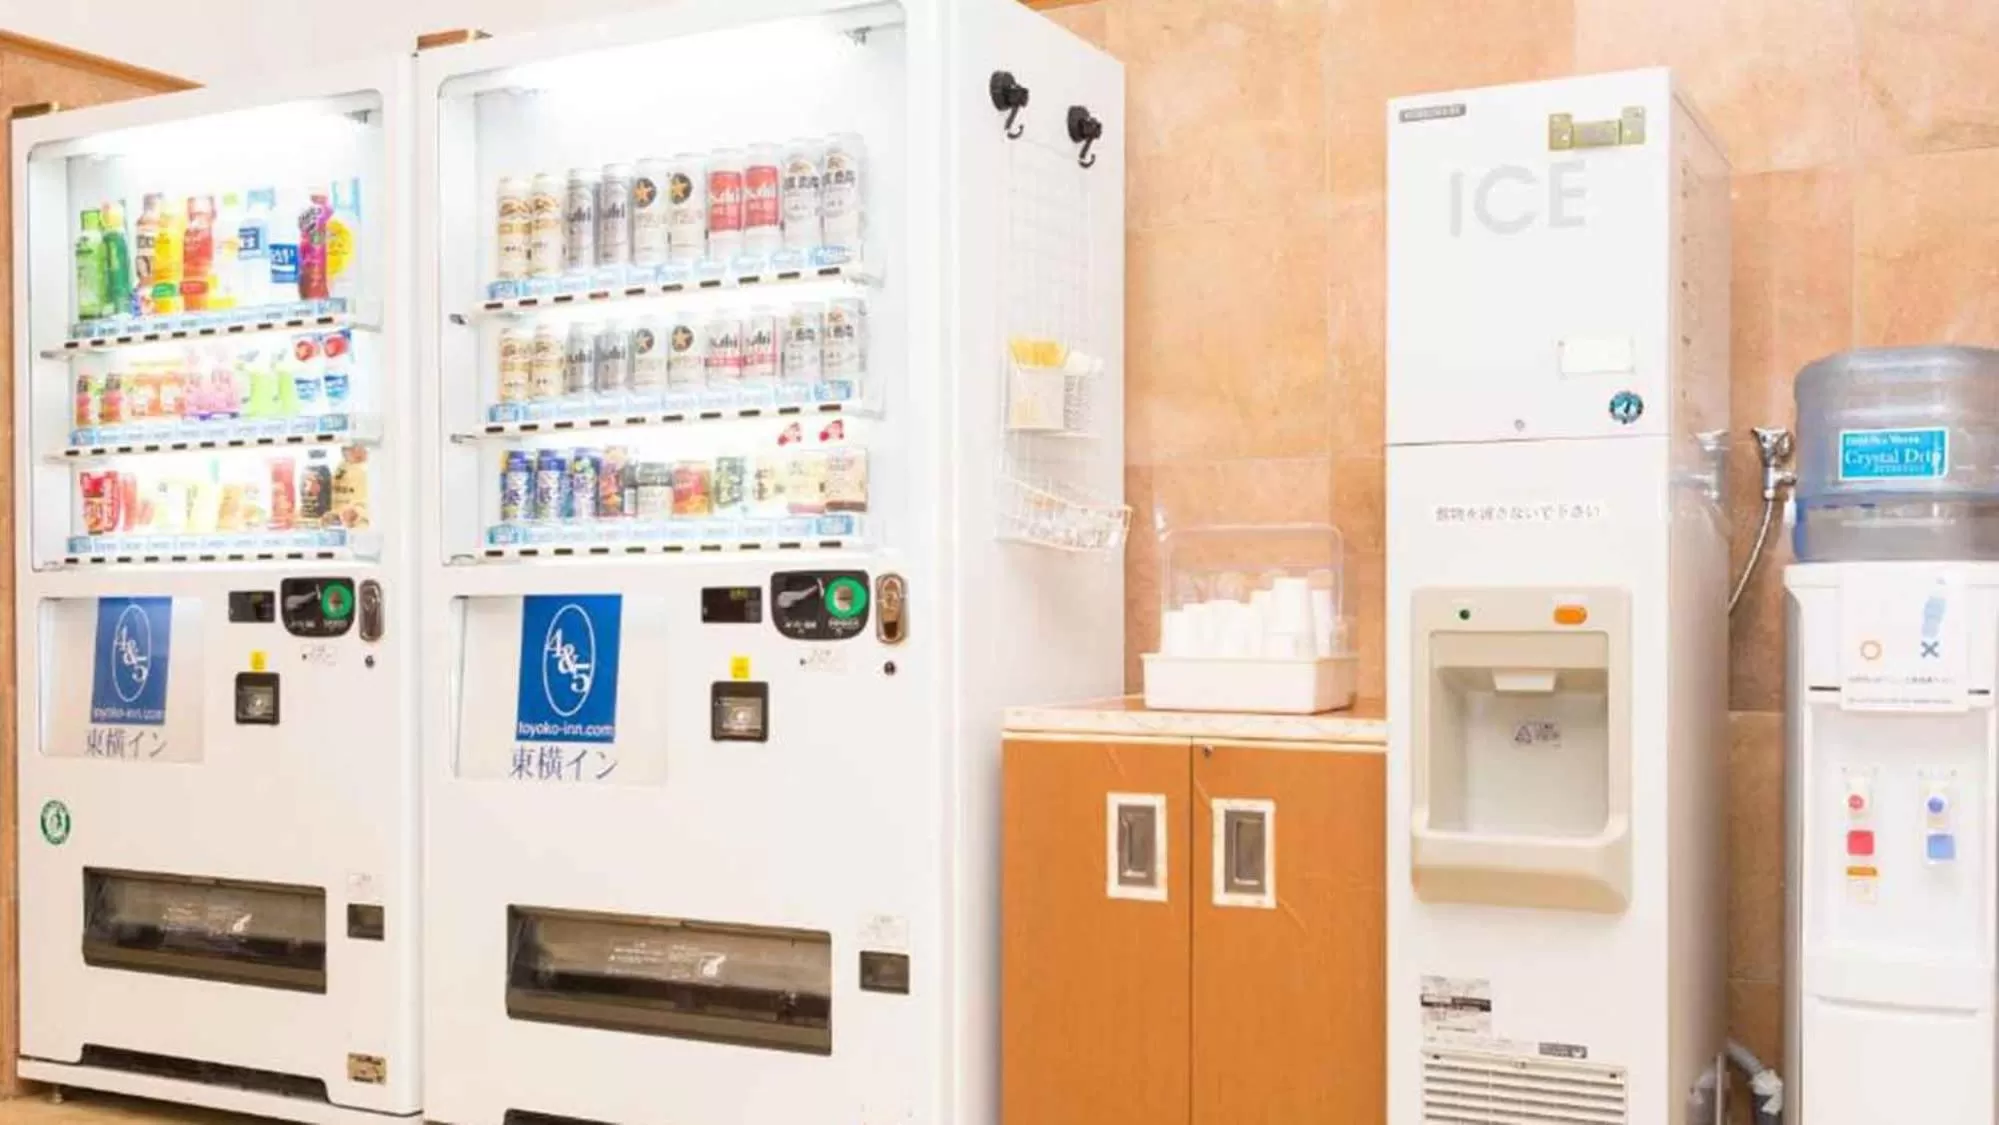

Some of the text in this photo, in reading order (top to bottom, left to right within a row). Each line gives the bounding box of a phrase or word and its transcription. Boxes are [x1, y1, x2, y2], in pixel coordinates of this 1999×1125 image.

[1450, 160, 1588, 238] ICE
[518, 720, 615, 739] toyoko-inn.com
[510, 744, 619, 781] 東横イン
